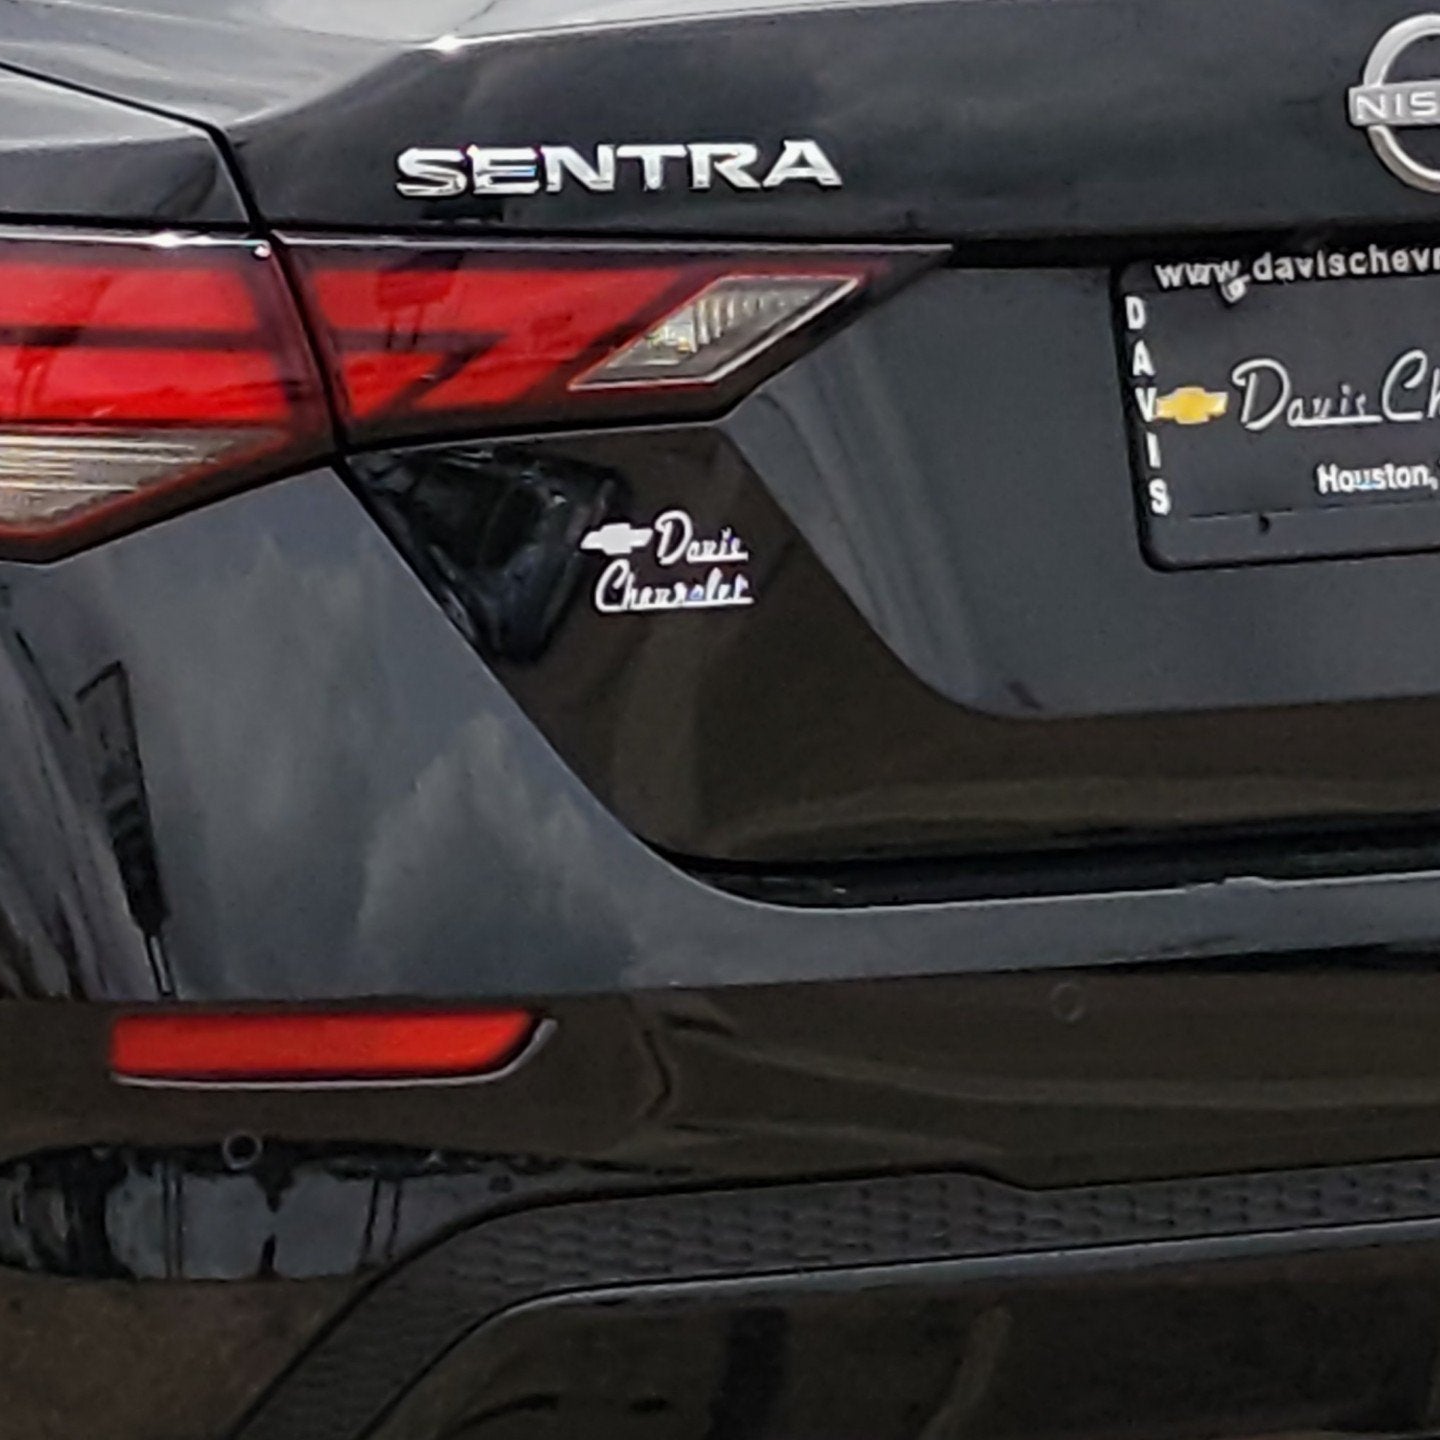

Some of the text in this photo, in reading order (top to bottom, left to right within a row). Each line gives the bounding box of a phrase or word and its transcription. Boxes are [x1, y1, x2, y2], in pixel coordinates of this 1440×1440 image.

[396, 139, 843, 196] SENTRA
[1125, 295, 1171, 516] DAVIS
[1231, 358, 1382, 431] Davis
[1318, 461, 1438, 495] Houston,
